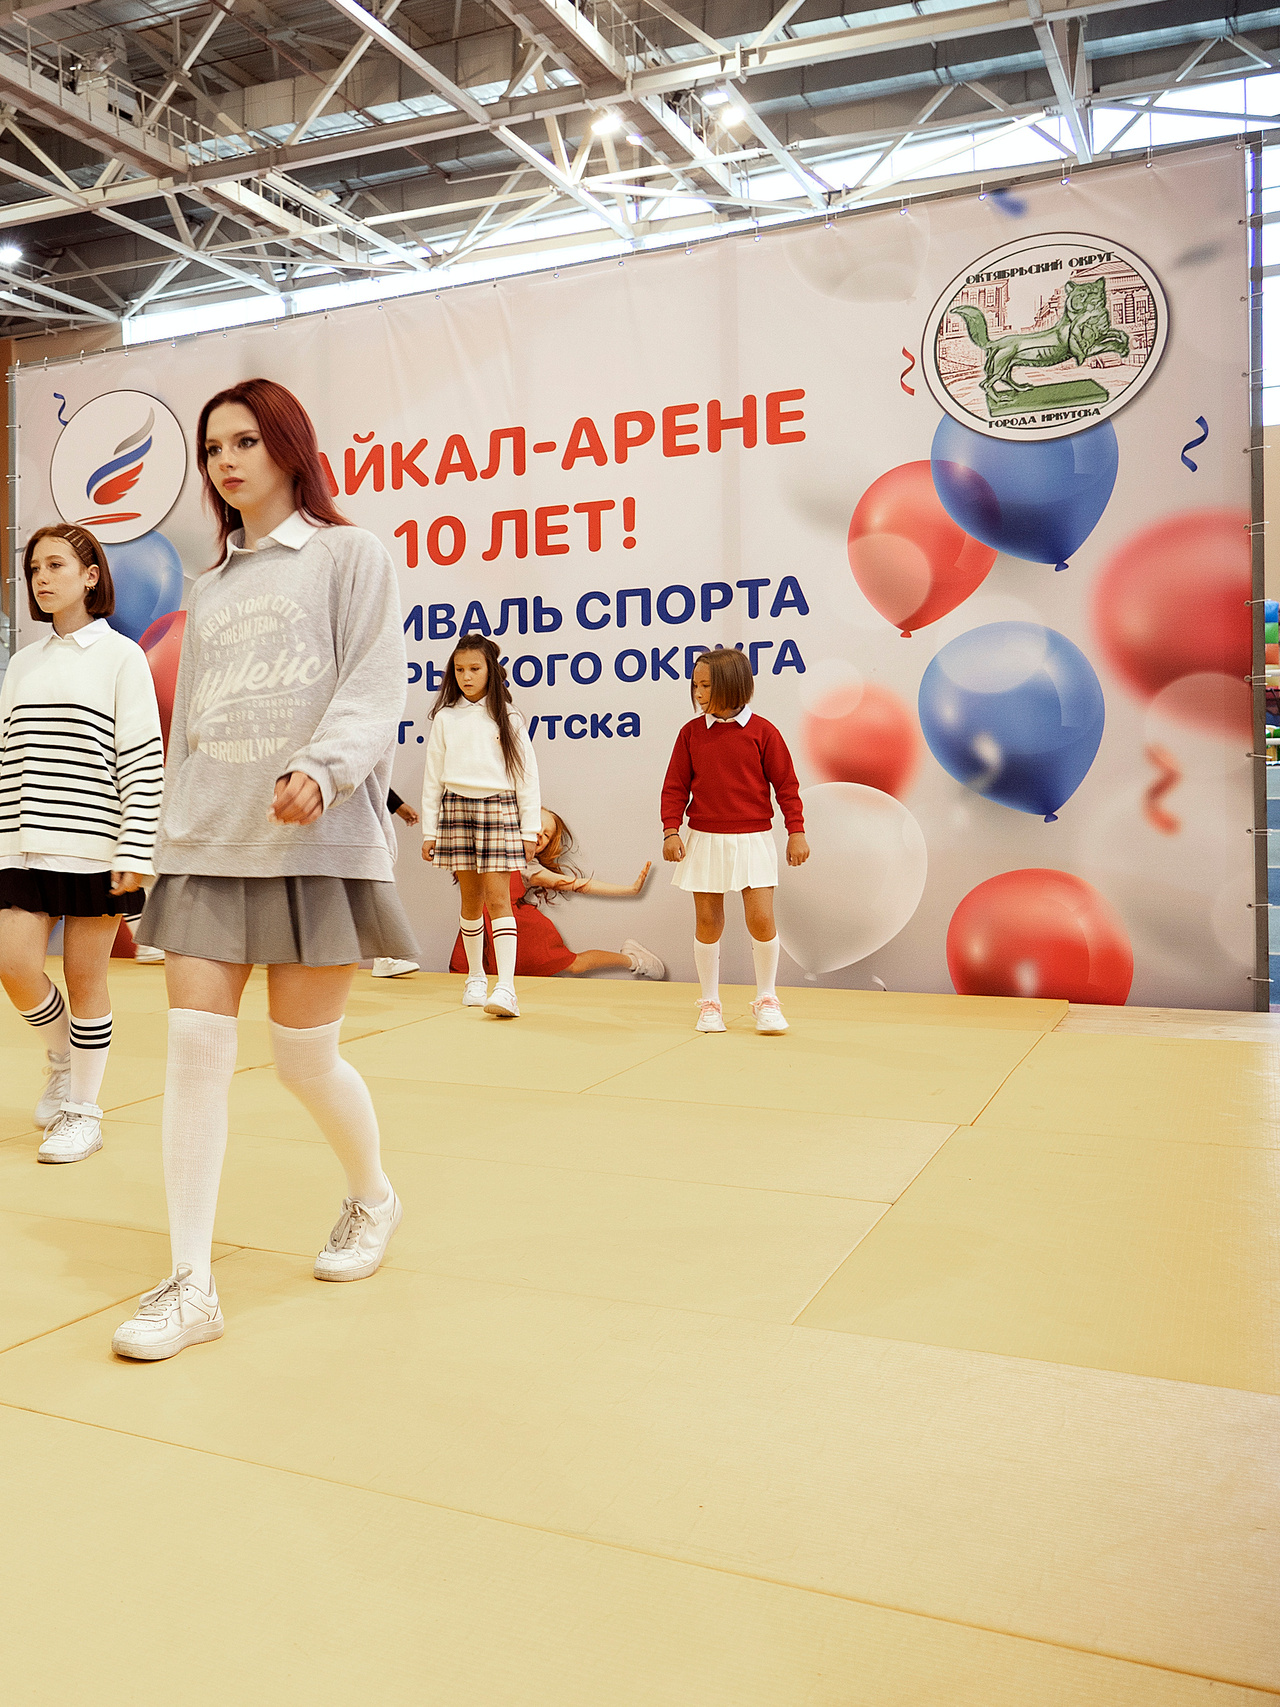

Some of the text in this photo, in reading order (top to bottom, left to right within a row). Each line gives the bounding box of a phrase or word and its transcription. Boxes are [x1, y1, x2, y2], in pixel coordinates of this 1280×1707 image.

[966, 251, 1115, 285] ОКТЯБРЬСКИЙ ОКРУГ
[988, 407, 1101, 429] ГОРОДА ИРКУТСКА
[393, 496, 638, 569] 10 ЛЕТ!
[199, 593, 308, 643] NEW YORK CITY
[576, 575, 810, 630] СПОРТА
[220, 615, 278, 646] DREAM TEAM
[397, 721, 425, 745] г.
[209, 737, 276, 764] BROOKLYN
